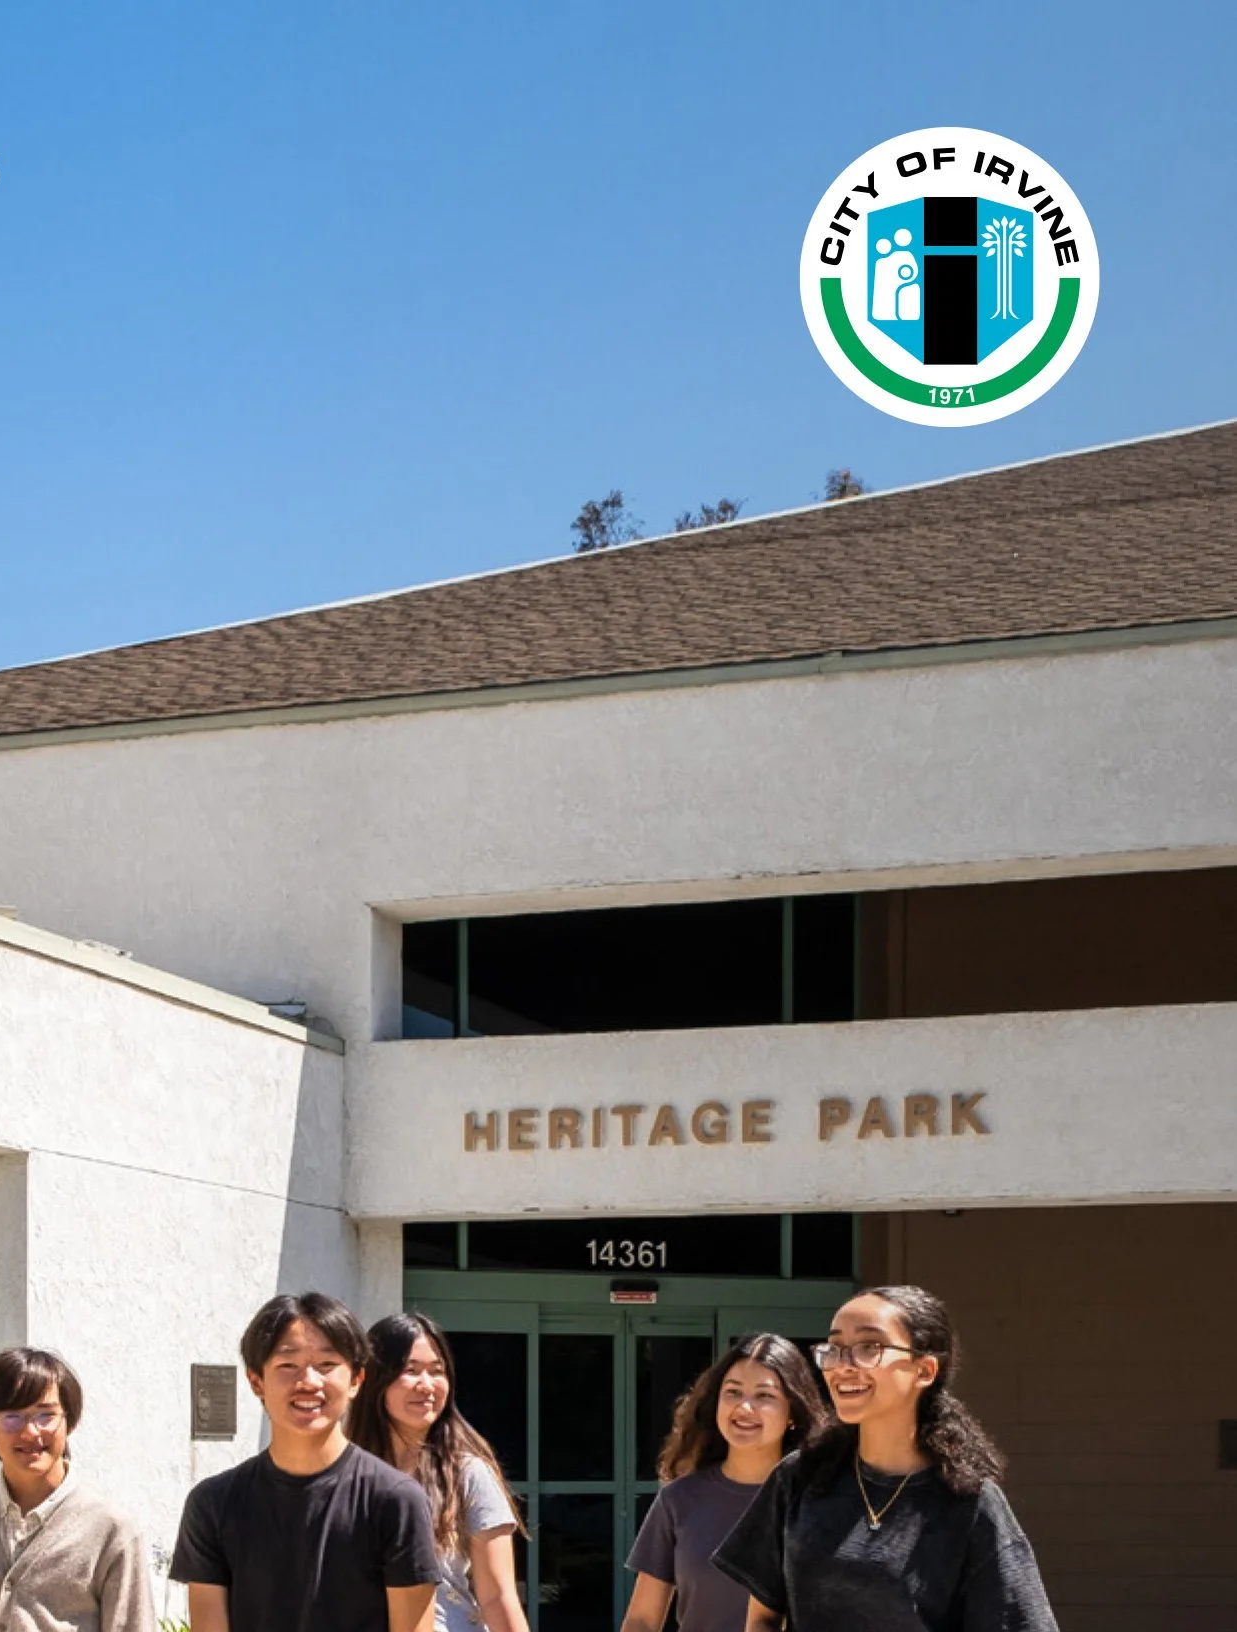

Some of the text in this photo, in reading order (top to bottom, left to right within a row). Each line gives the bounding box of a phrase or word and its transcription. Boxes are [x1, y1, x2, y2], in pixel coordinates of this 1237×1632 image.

[464, 1092, 990, 1152] HERITAGE PARK
[585, 1238, 667, 1268] 14361
